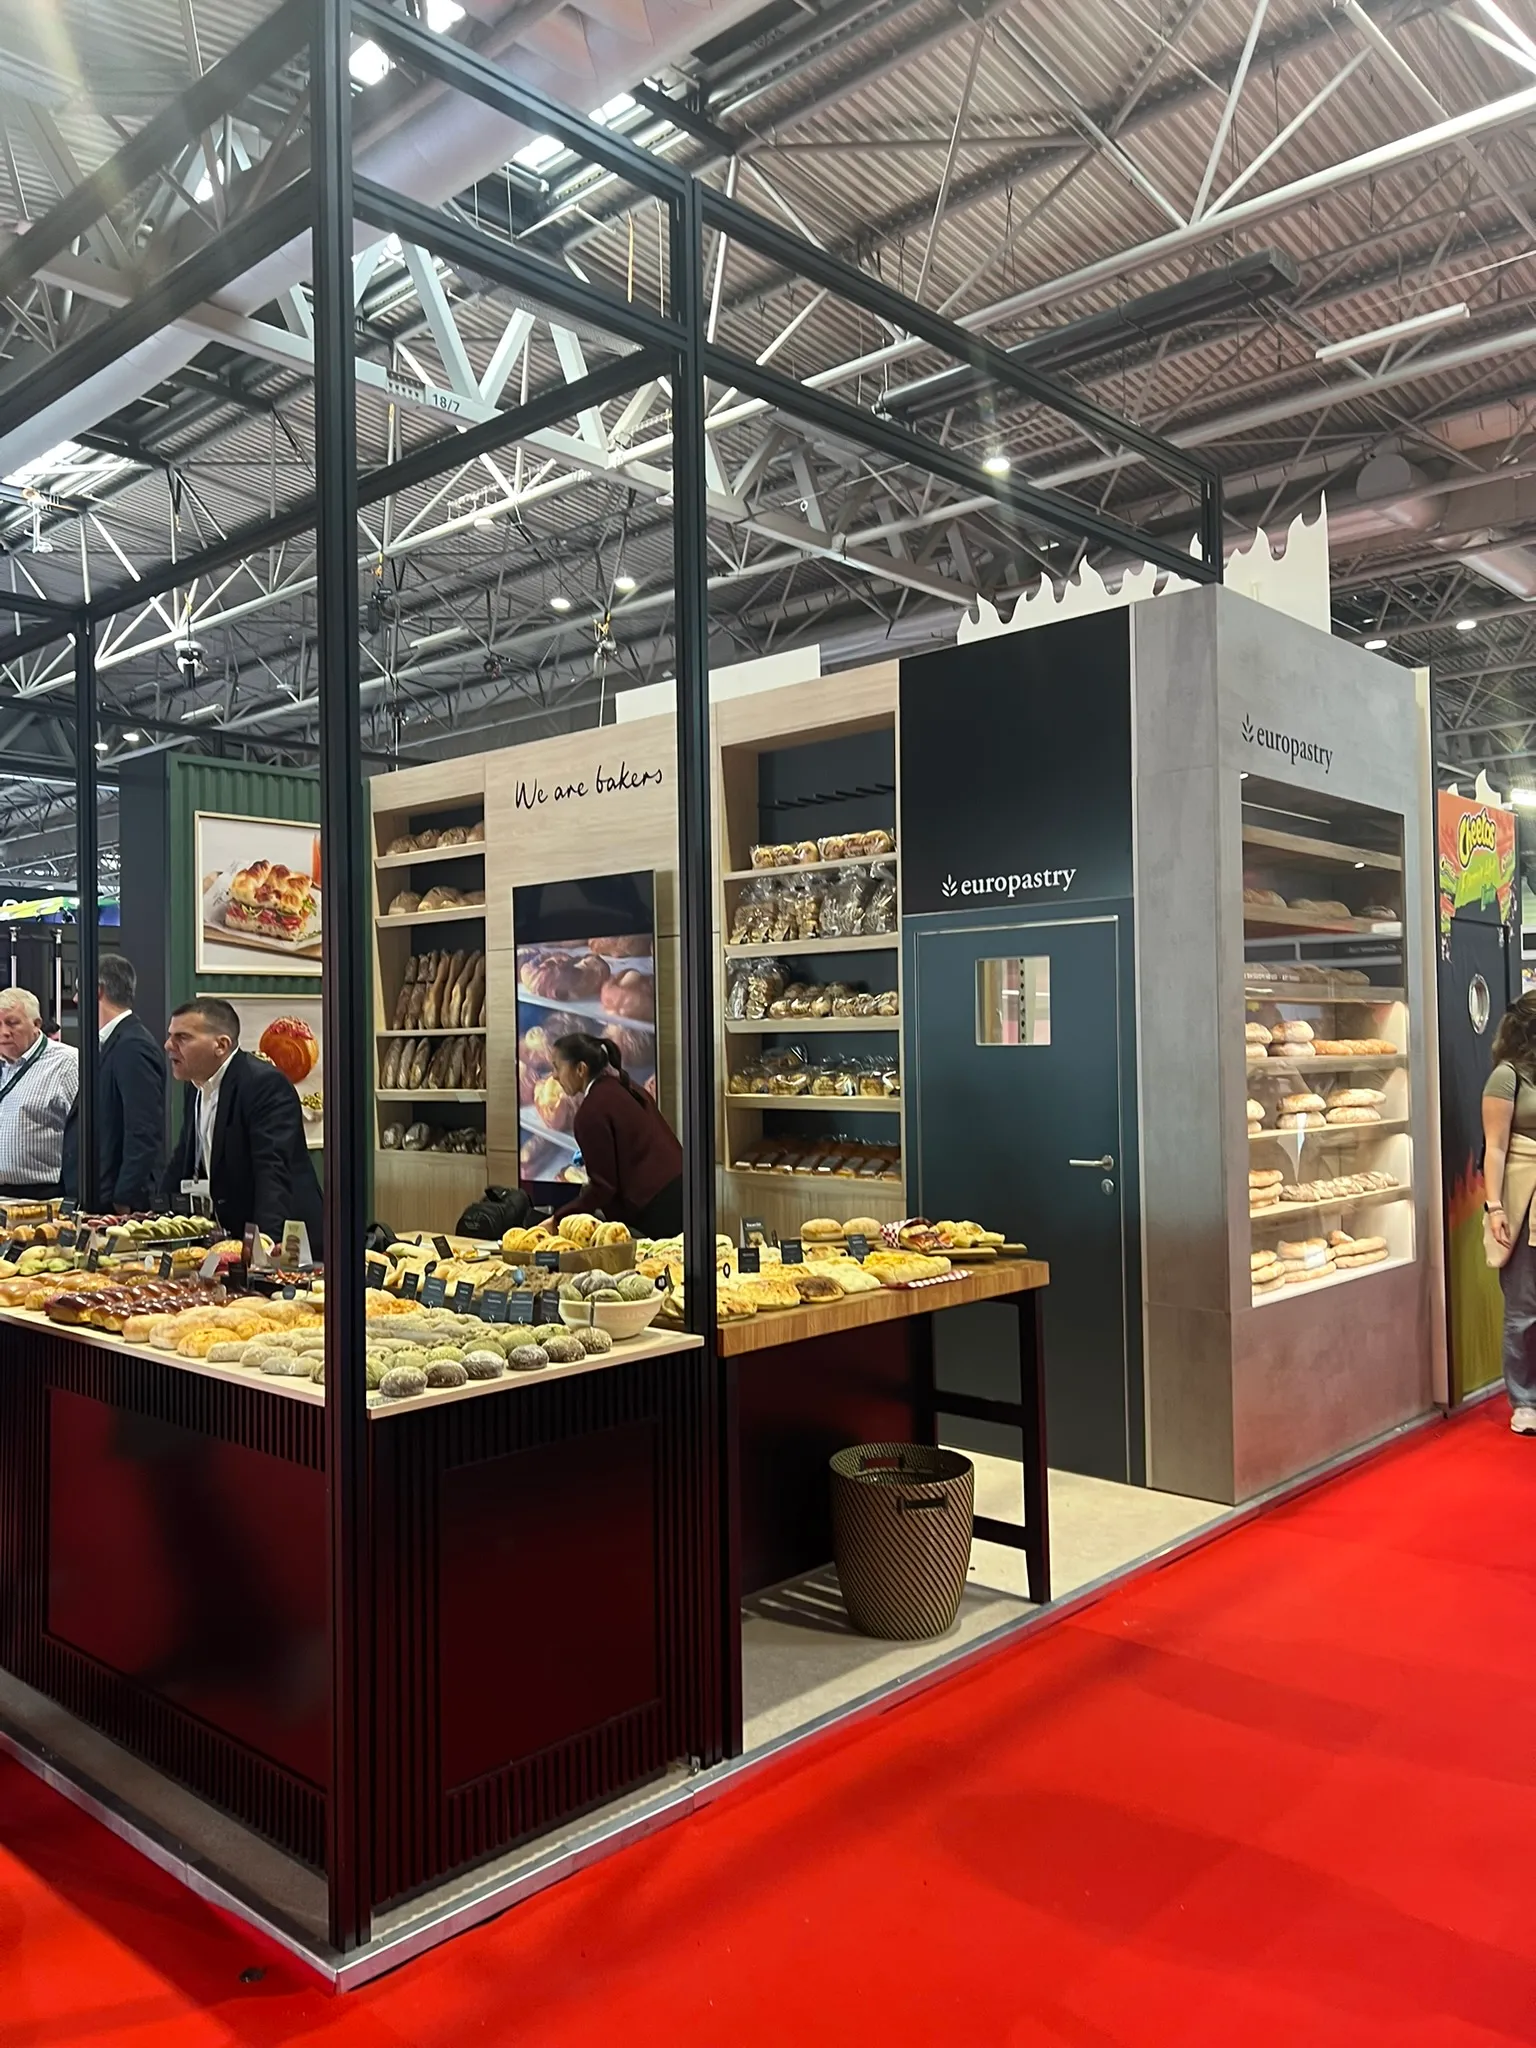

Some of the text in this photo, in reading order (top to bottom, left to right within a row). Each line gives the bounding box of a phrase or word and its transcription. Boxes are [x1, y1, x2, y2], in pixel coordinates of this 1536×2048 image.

[432, 393, 461, 413] 18/7
[1256, 727, 1333, 774] europastry
[515, 761, 663, 809] We are bakers
[1458, 807, 1496, 869] Cheetos
[961, 868, 1077, 898] europastry
